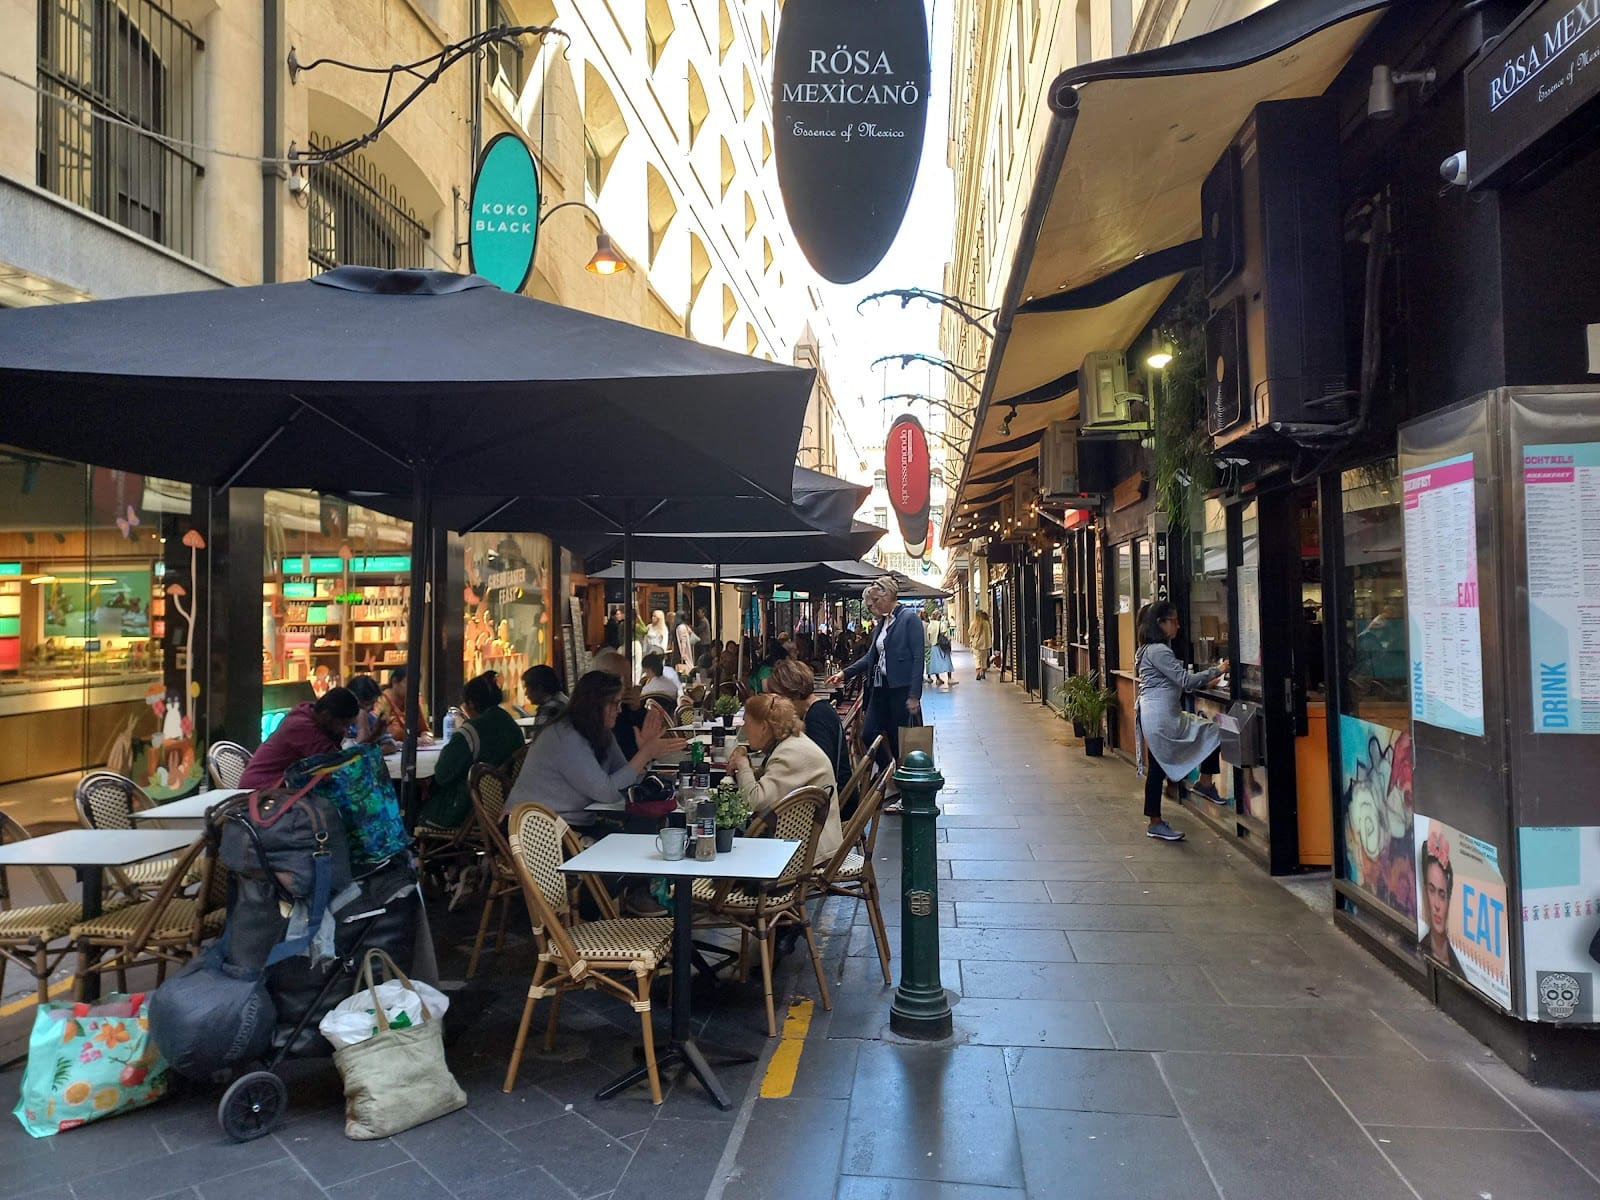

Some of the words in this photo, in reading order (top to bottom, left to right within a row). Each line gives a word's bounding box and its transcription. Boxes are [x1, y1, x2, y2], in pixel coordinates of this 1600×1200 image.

[808, 44, 894, 75] RÖSA
[1490, 45, 1541, 107] RÖSA
[1538, 78, 1565, 103] Essence
[1566, 62, 1575, 86] of
[792, 121, 837, 137] Essence
[840, 124, 854, 143] of
[857, 121, 905, 138] Mexico
[475, 220, 531, 234] BLACK
[482, 203, 528, 216] KOKO
[1457, 581, 1477, 608] EAT
[1413, 660, 1424, 716] DRINK
[1540, 662, 1569, 728] DRINK
[1461, 883, 1504, 958] EAT
